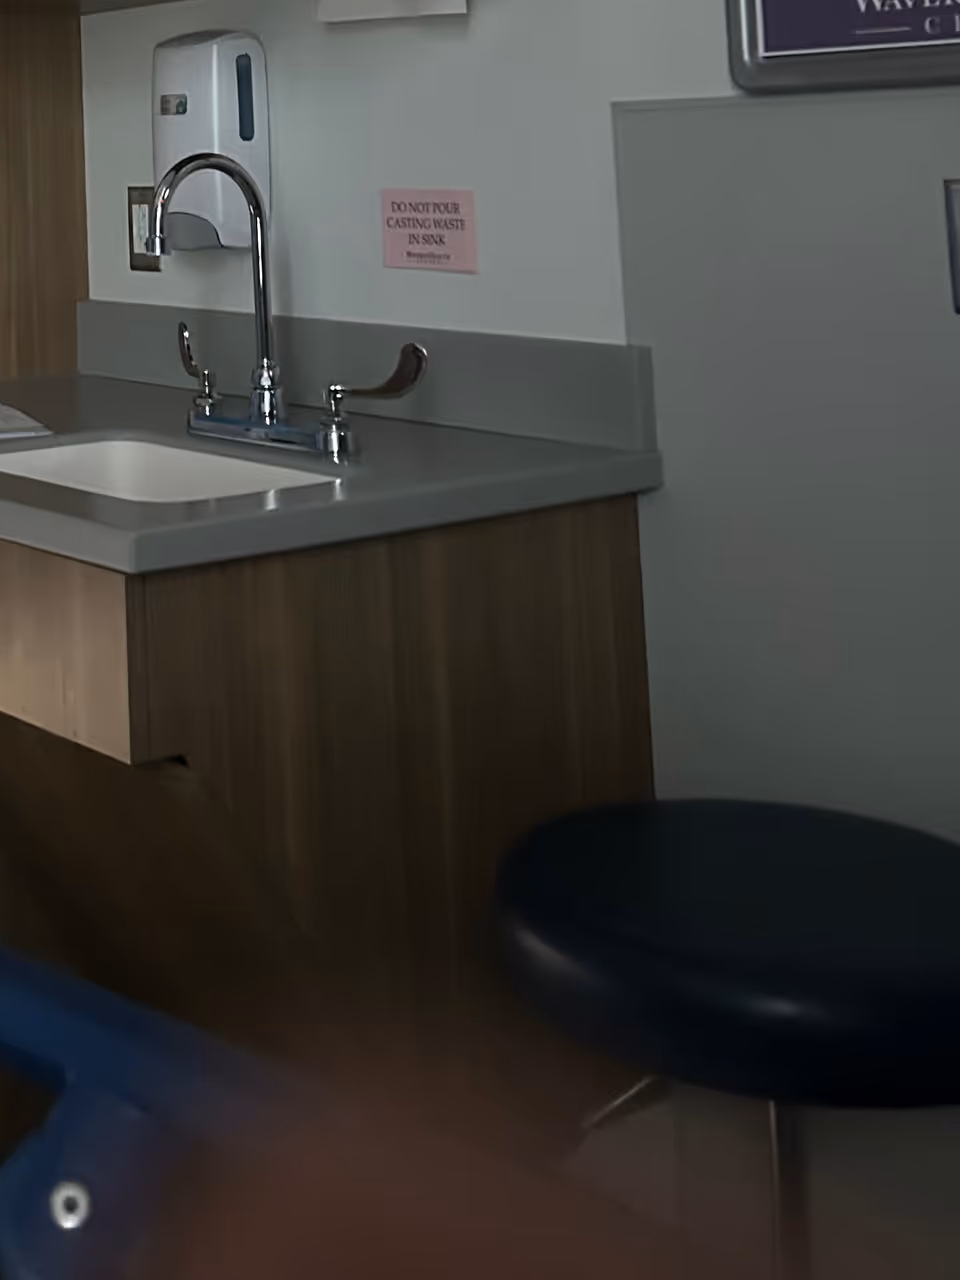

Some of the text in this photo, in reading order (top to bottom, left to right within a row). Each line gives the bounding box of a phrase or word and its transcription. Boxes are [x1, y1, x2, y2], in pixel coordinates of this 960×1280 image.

[391, 201, 460, 215] DO NOT POUR
[386, 216, 466, 231] CASTING WASTE
[408, 233, 446, 246] IN SINK
